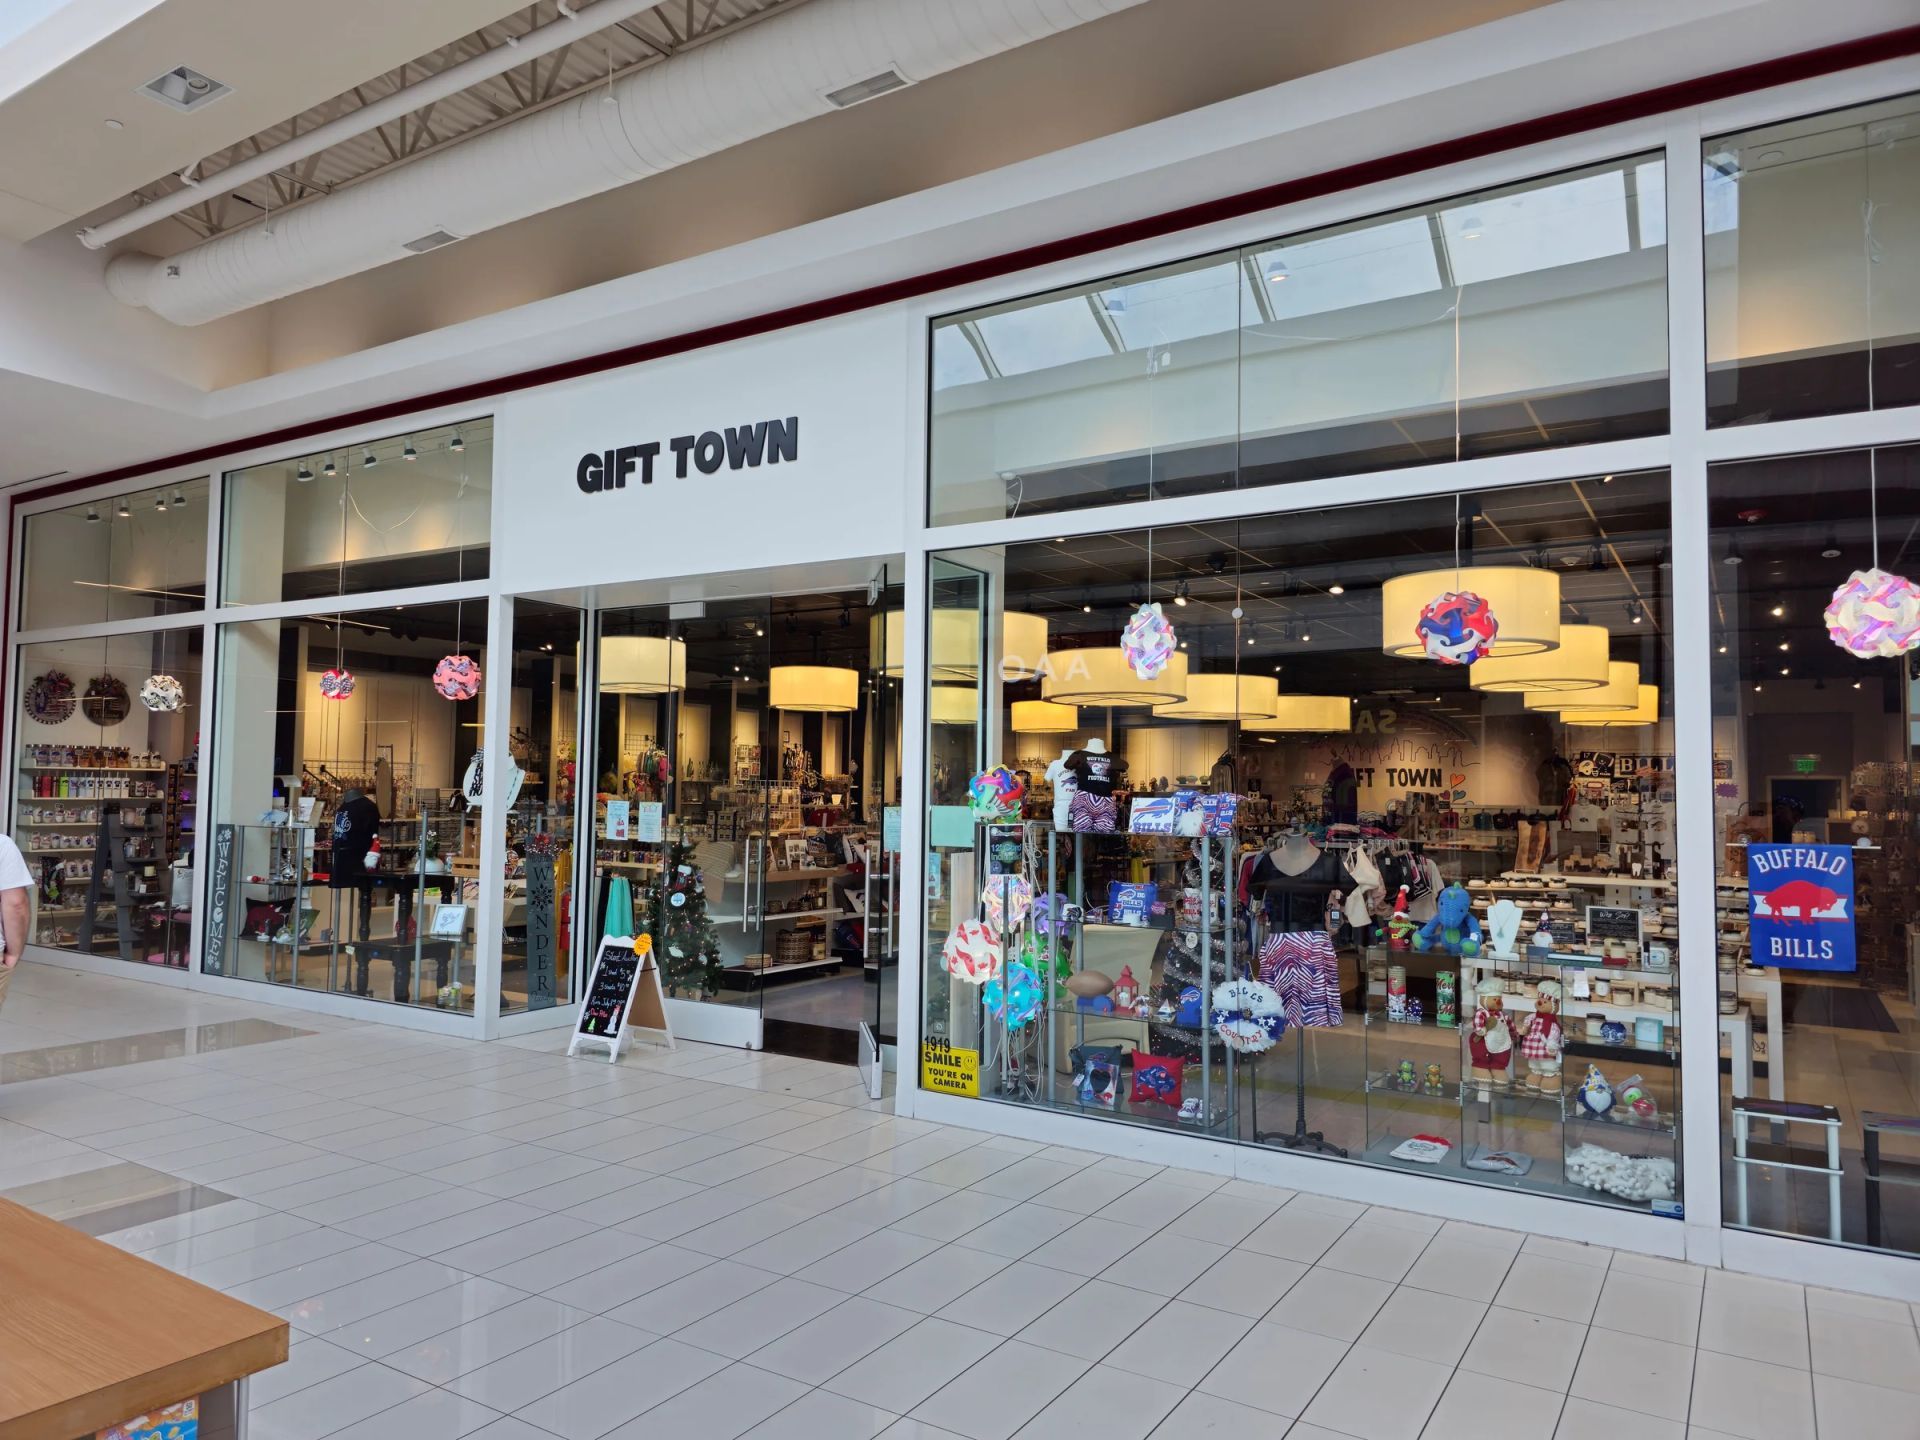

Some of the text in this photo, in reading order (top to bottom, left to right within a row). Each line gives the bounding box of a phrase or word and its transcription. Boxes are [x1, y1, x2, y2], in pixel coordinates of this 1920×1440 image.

[577, 416, 798, 494] GIFT TOWN
[1386, 768, 1442, 787] TOWN
[1132, 822, 1172, 833] BILLS
[1751, 848, 1847, 876] BUFFALO
[1770, 937, 1834, 959] BILLS
[924, 1035, 951, 1053] 1919
[924, 1051, 962, 1067] SMILE
[928, 1067, 973, 1081] YOU'RE ON
[933, 1078, 967, 1090] CAMERA
